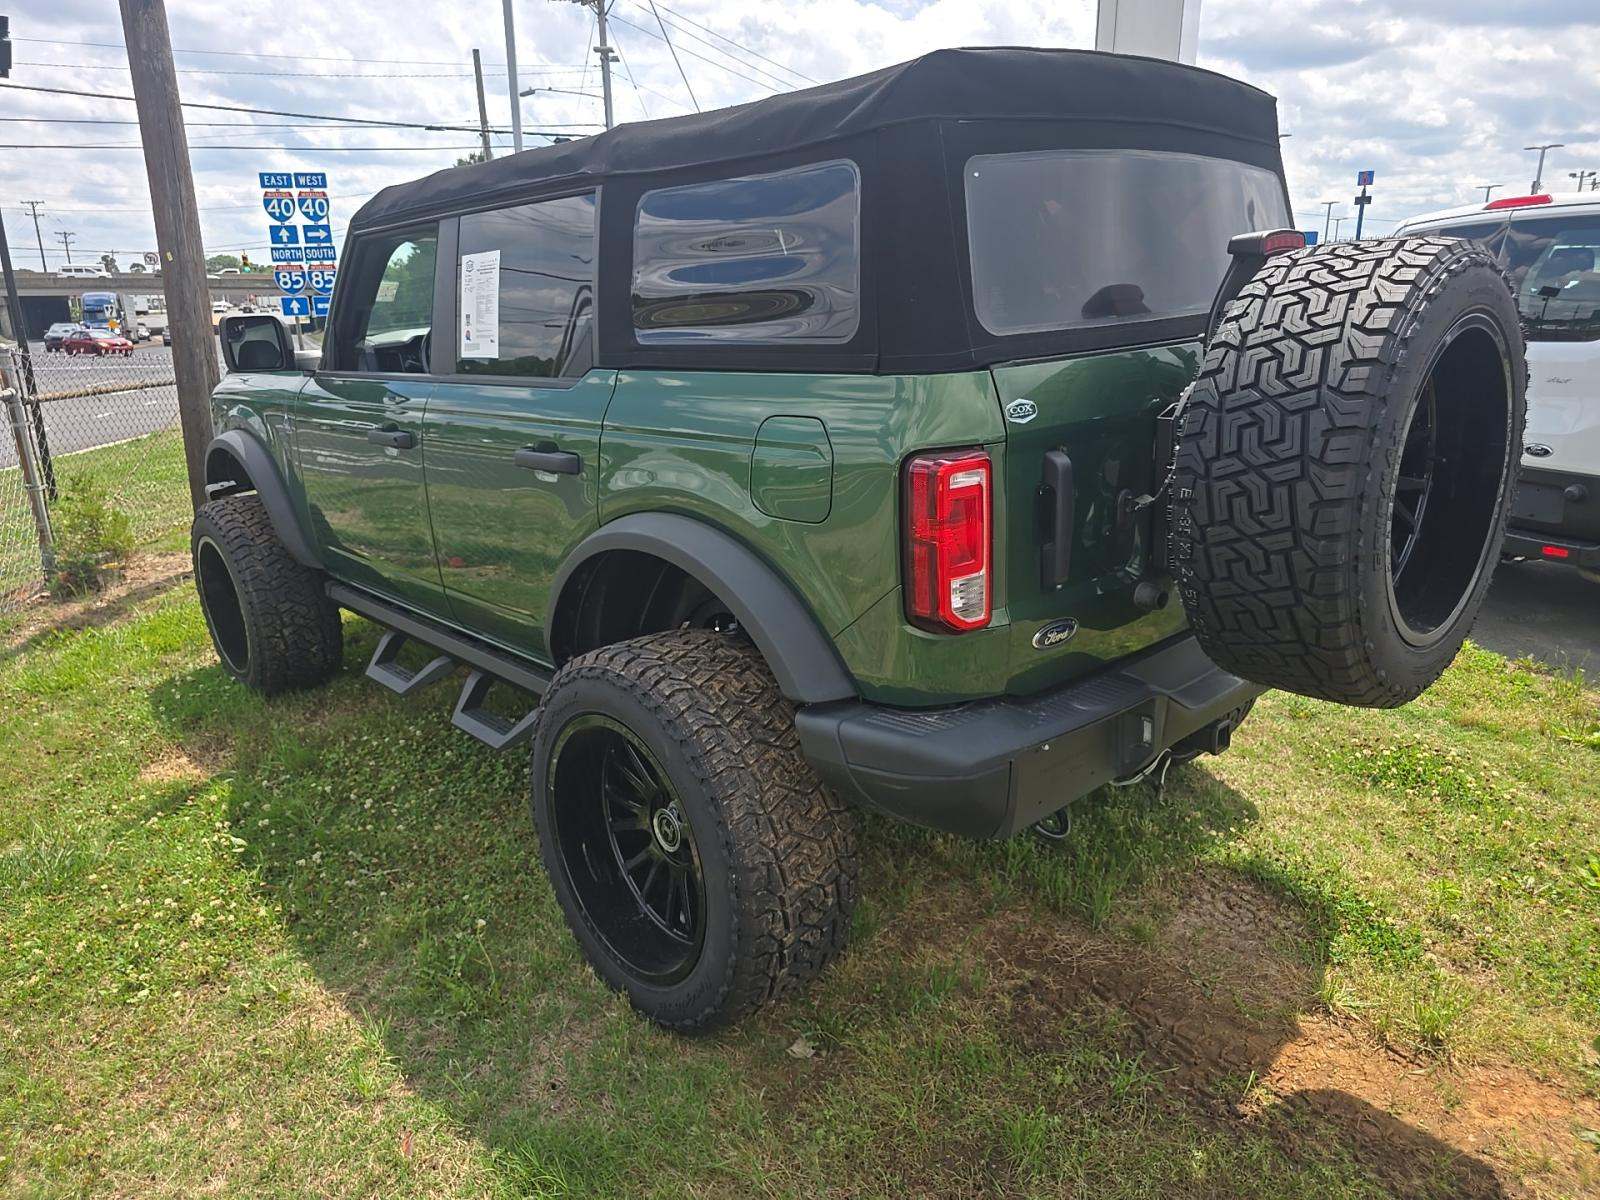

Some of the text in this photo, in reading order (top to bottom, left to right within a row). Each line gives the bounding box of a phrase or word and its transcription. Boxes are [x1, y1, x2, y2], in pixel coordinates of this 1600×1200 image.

[264, 175, 288, 186] EAST
[298, 175, 322, 186] WEST
[267, 198, 294, 217] 40
[301, 198, 328, 217] 40
[272, 249, 302, 260] NORTH
[305, 248, 335, 259] SOUTH
[279, 271, 304, 289] 85
[311, 271, 335, 289] 85
[1010, 403, 1033, 414] COX
[1044, 627, 1069, 645] Ford
